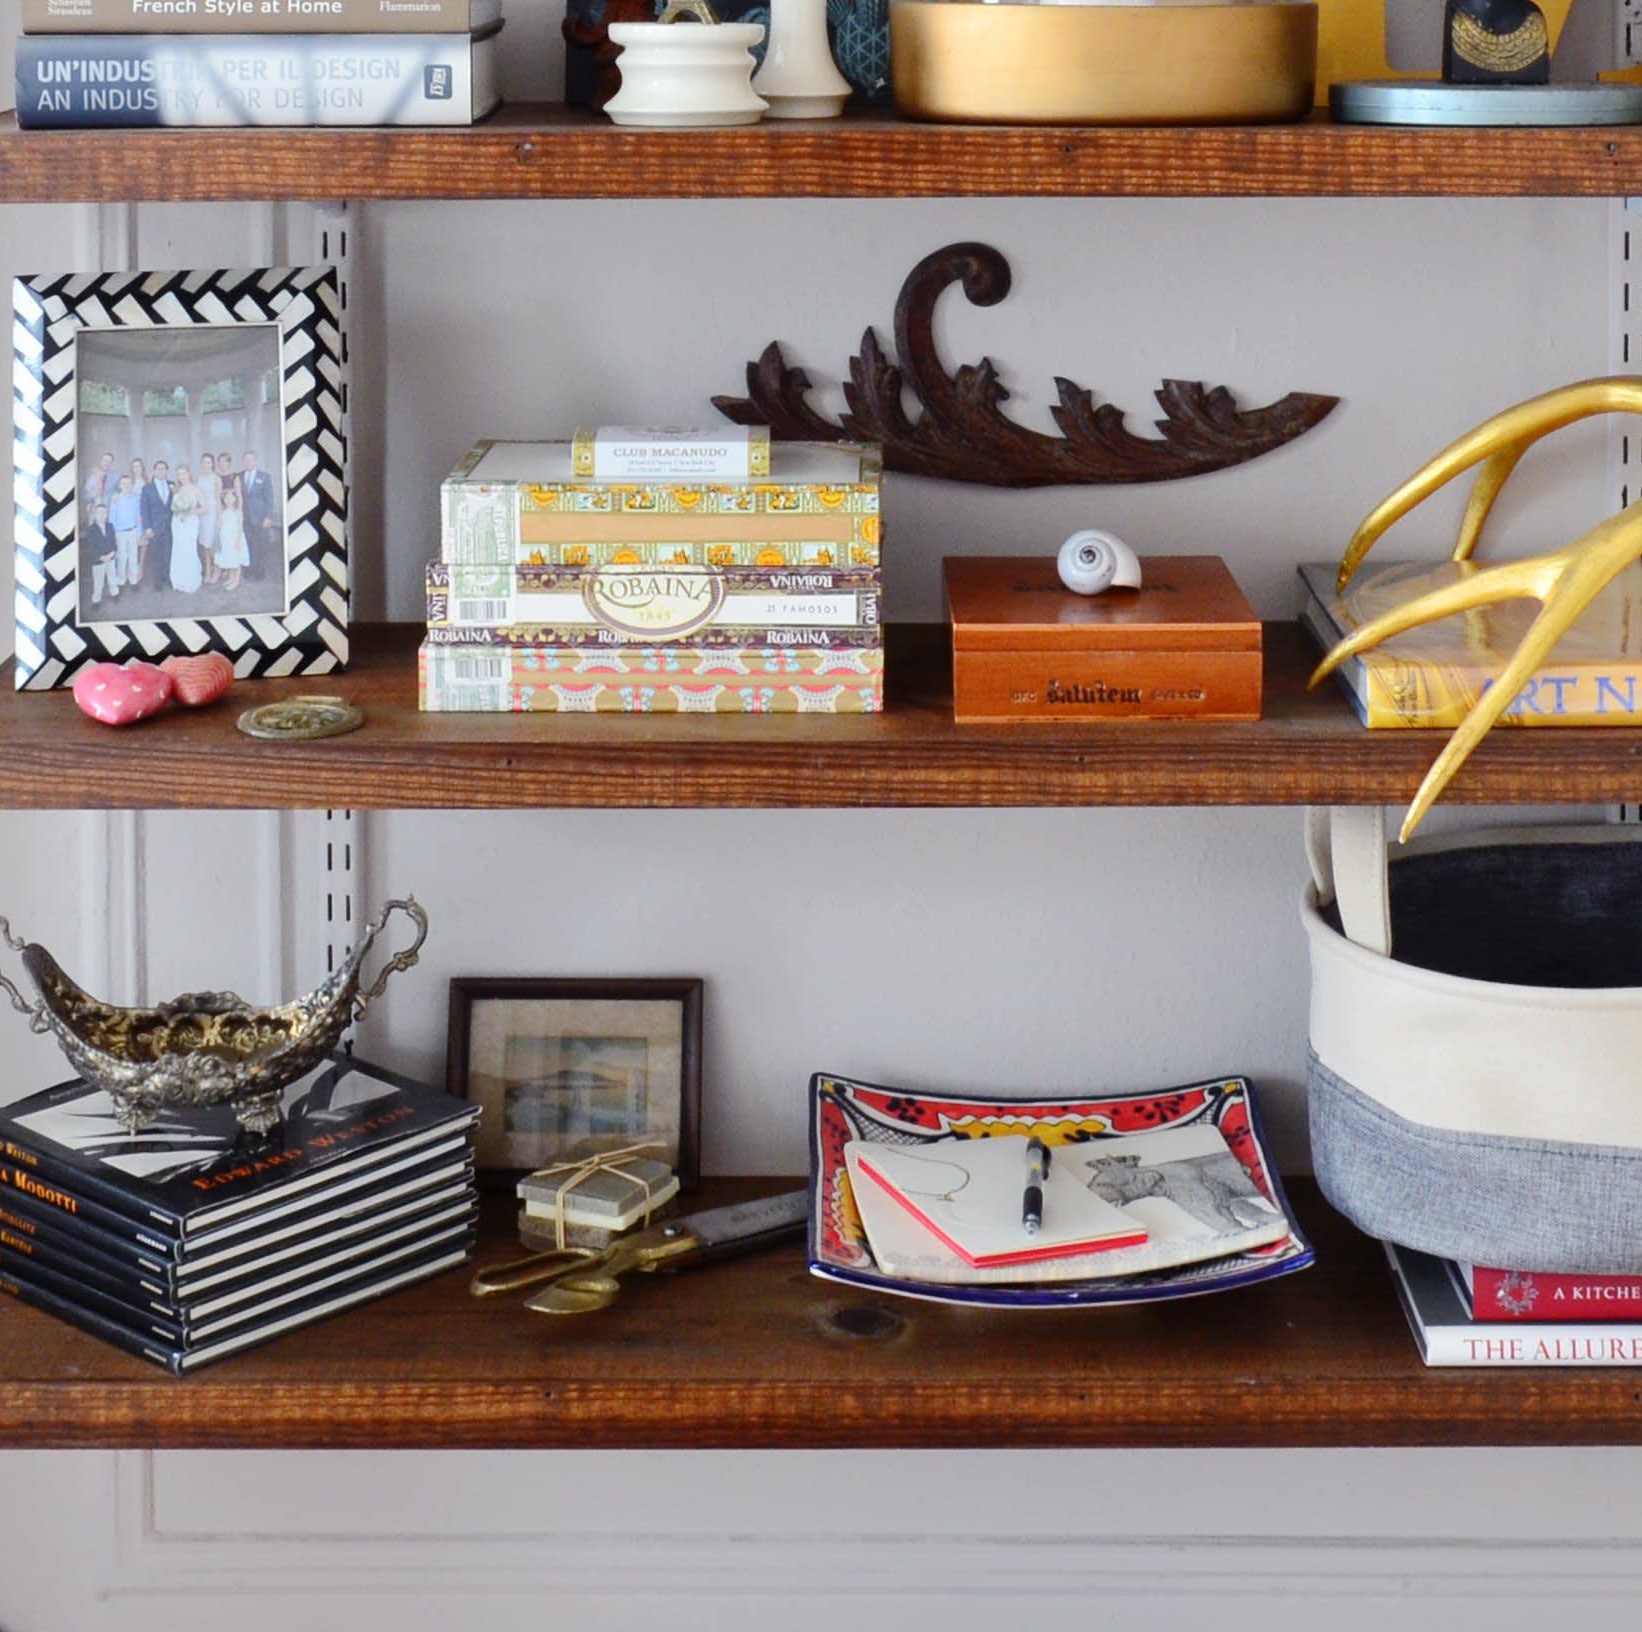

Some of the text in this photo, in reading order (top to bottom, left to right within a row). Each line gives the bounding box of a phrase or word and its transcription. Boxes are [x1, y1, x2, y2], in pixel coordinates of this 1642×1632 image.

[132, 0, 197, 14] French
[261, 0, 279, 14] at
[288, 0, 343, 14] Home
[379, 0, 442, 13] Flammarion
[37, 58, 401, 83] UN'INDUST PER IL DESIGN
[37, 89, 72, 111] AN
[83, 89, 204, 111] INDUSTRY
[274, 88, 363, 109] DESIGN
[613, 447, 728, 457] CLUB MACANUDO
[769, 575, 833, 588] ROBAINA
[782, 604, 838, 614] FAMOSOS
[428, 628, 492, 643] ROBAINA
[765, 630, 830, 644] ROBAINA
[1481, 676, 1578, 714] RT
[193, 1148, 303, 1191] EDWARD
[13, 1169, 79, 1214] MODOTTI
[1553, 1286, 1566, 1300] A
[1463, 1338, 1523, 1361] THE
